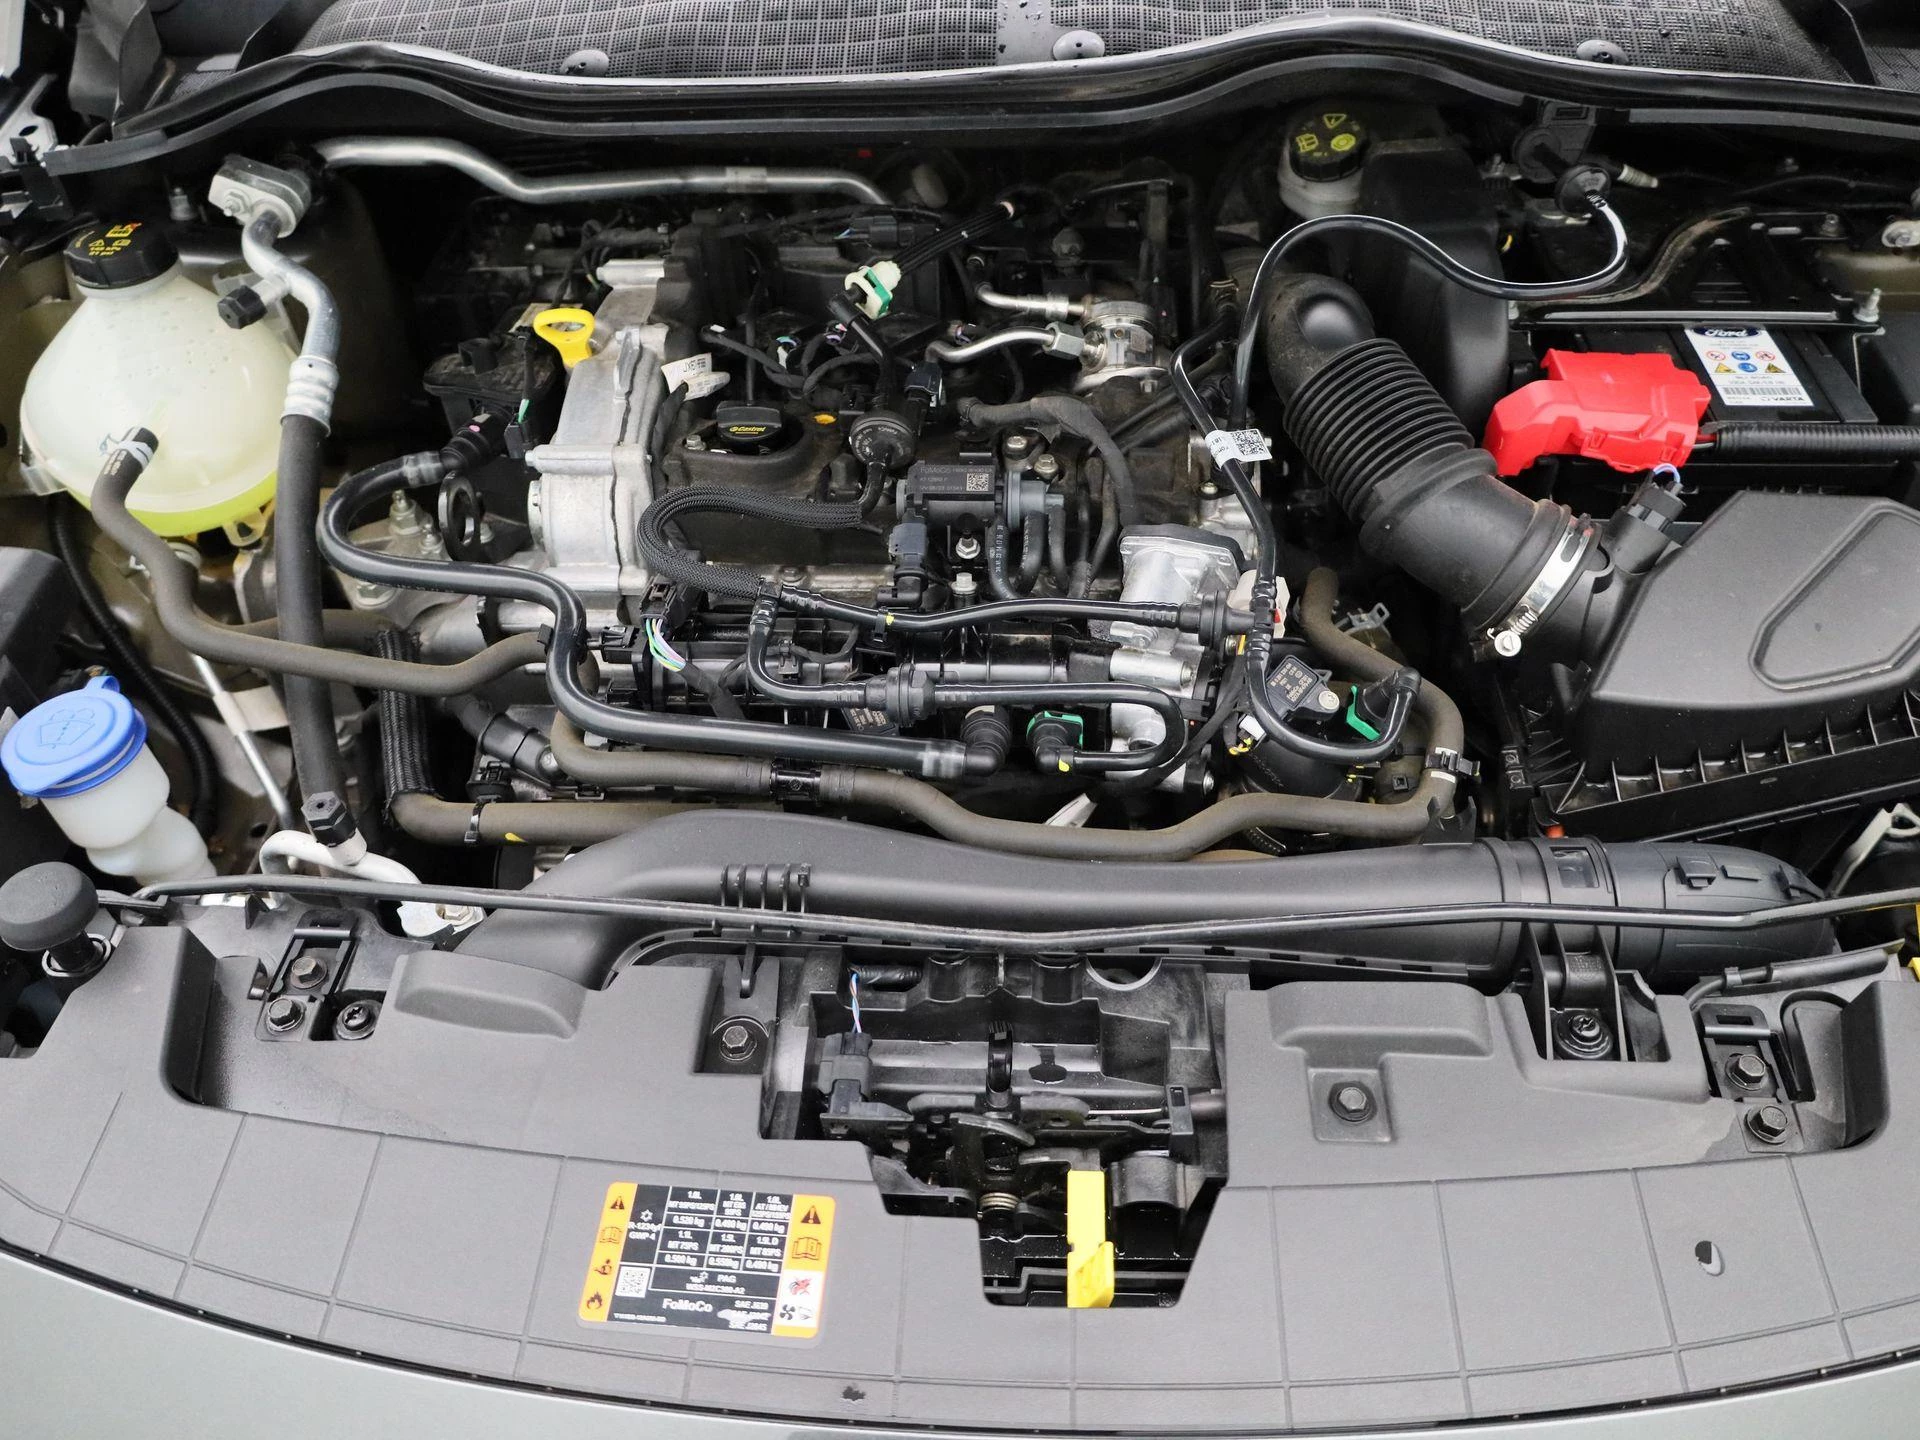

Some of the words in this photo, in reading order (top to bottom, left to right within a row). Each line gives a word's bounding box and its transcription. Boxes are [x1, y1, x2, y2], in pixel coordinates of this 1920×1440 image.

[1704, 328, 1749, 337] Ford
[694, 1217, 705, 1228] kg
[736, 1220, 747, 1231] kg
[774, 1223, 785, 1234] kg
[686, 1255, 697, 1266] kg
[717, 1274, 737, 1284] PAG
[663, 1298, 713, 1312] FoMoCo
[734, 1300, 751, 1309] SAE
